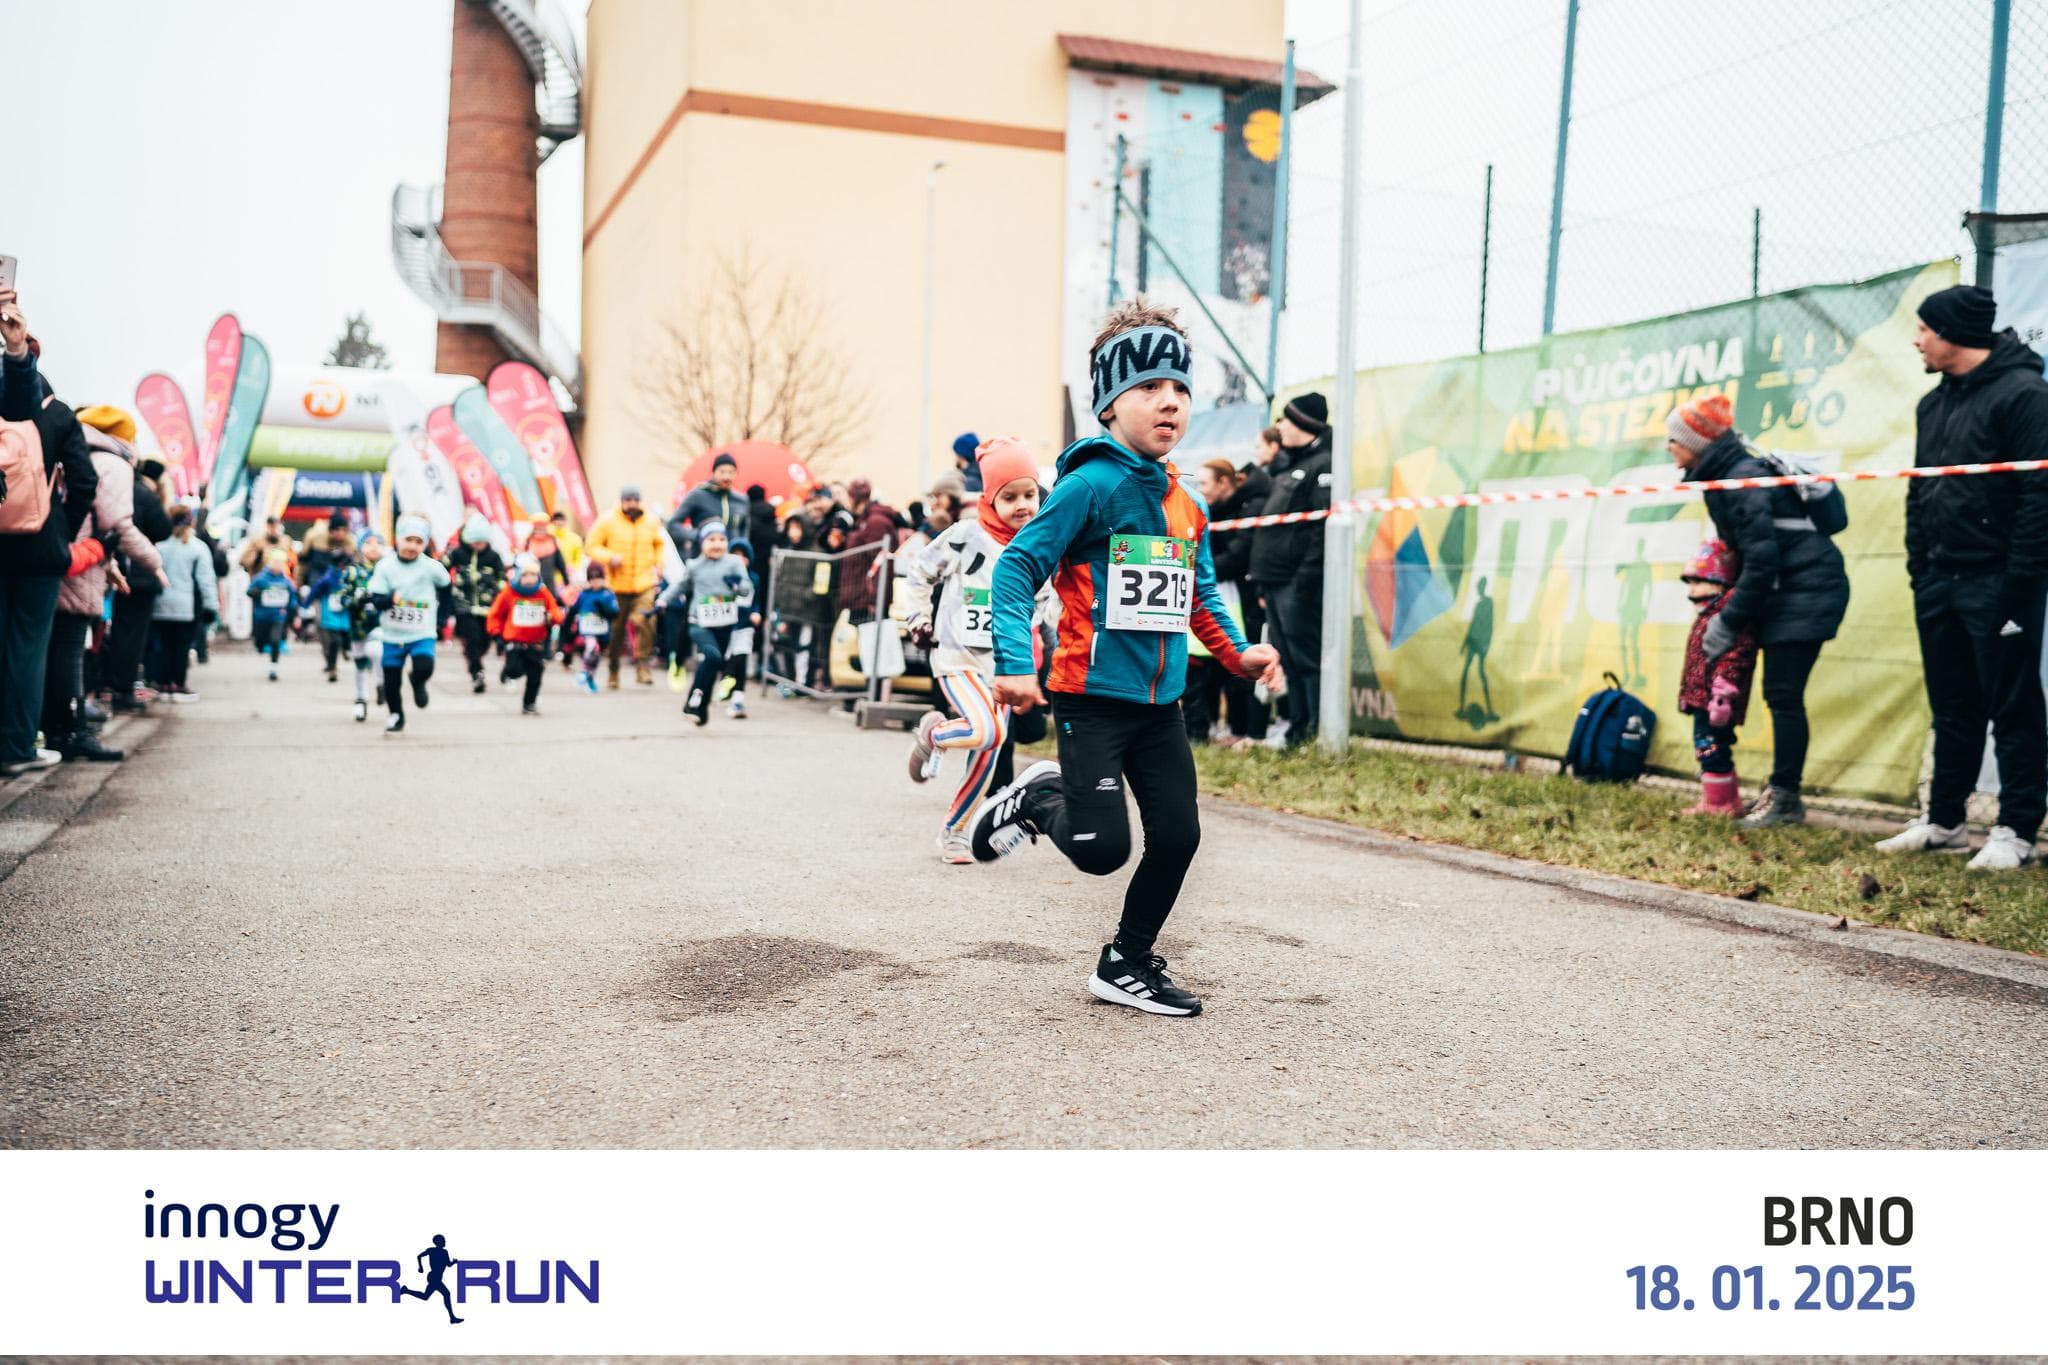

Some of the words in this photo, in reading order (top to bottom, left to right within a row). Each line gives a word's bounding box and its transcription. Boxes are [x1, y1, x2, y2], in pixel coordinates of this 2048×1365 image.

[1534, 337, 1744, 406] PŮJČOVNA
[1504, 408, 1569, 453] NA
[1119, 569, 1187, 609] 3219
